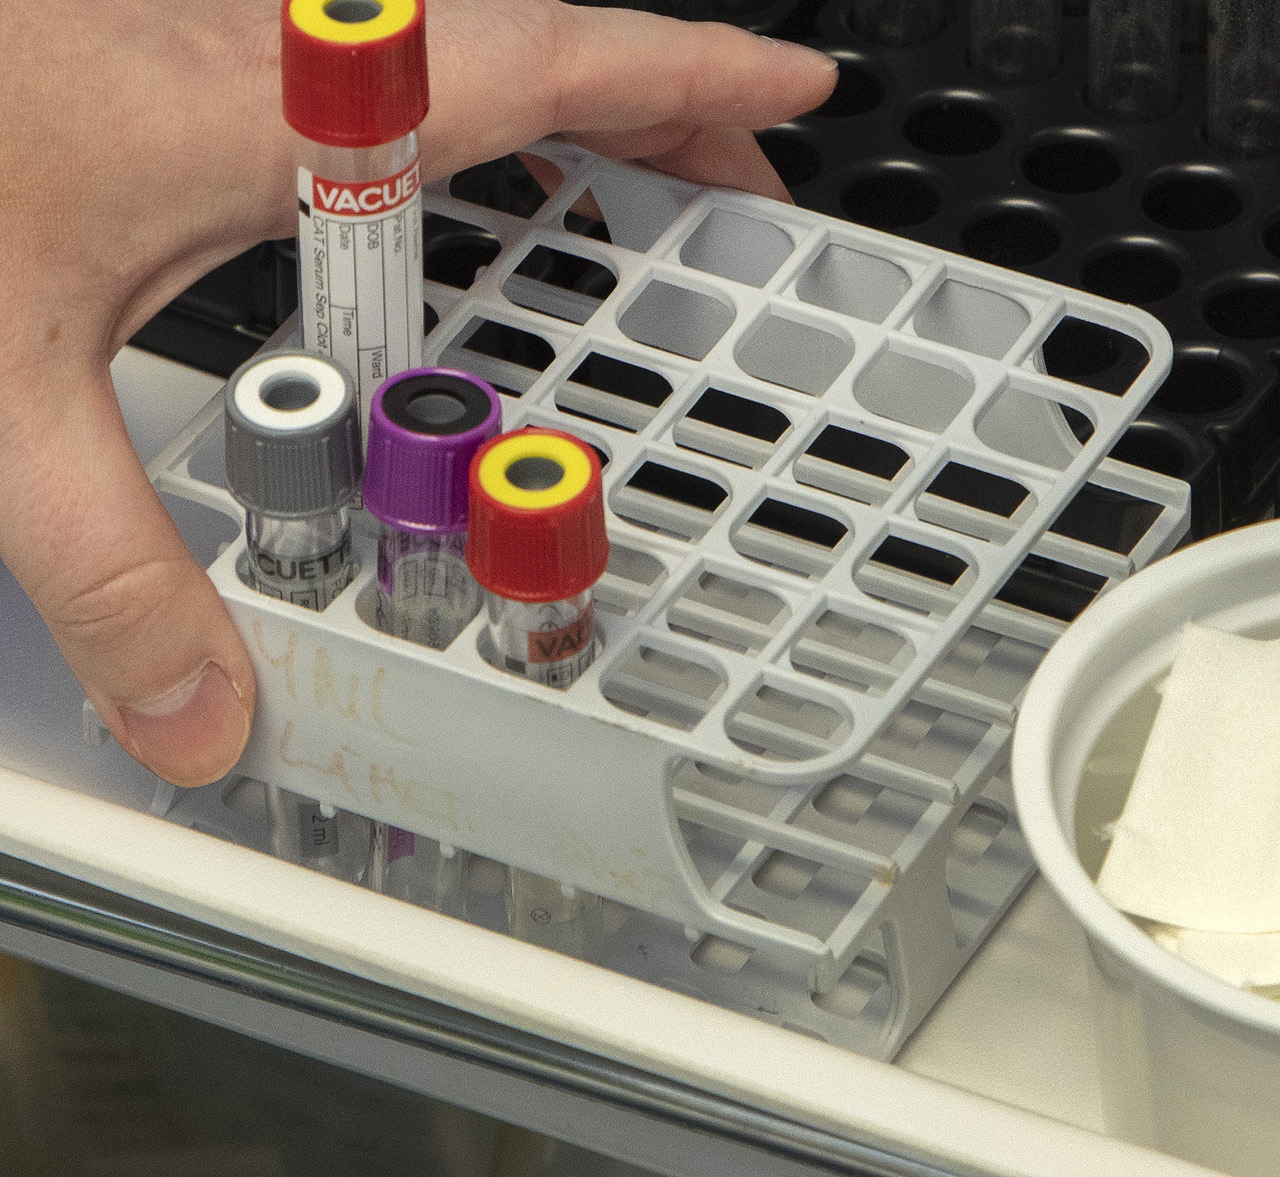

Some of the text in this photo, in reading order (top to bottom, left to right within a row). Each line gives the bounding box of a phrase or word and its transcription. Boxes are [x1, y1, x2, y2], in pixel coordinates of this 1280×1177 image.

[312, 214, 329, 349] CAT Serum Sep Clot
[338, 222, 354, 338] Date Time
[366, 222, 383, 380] DOB Ward
